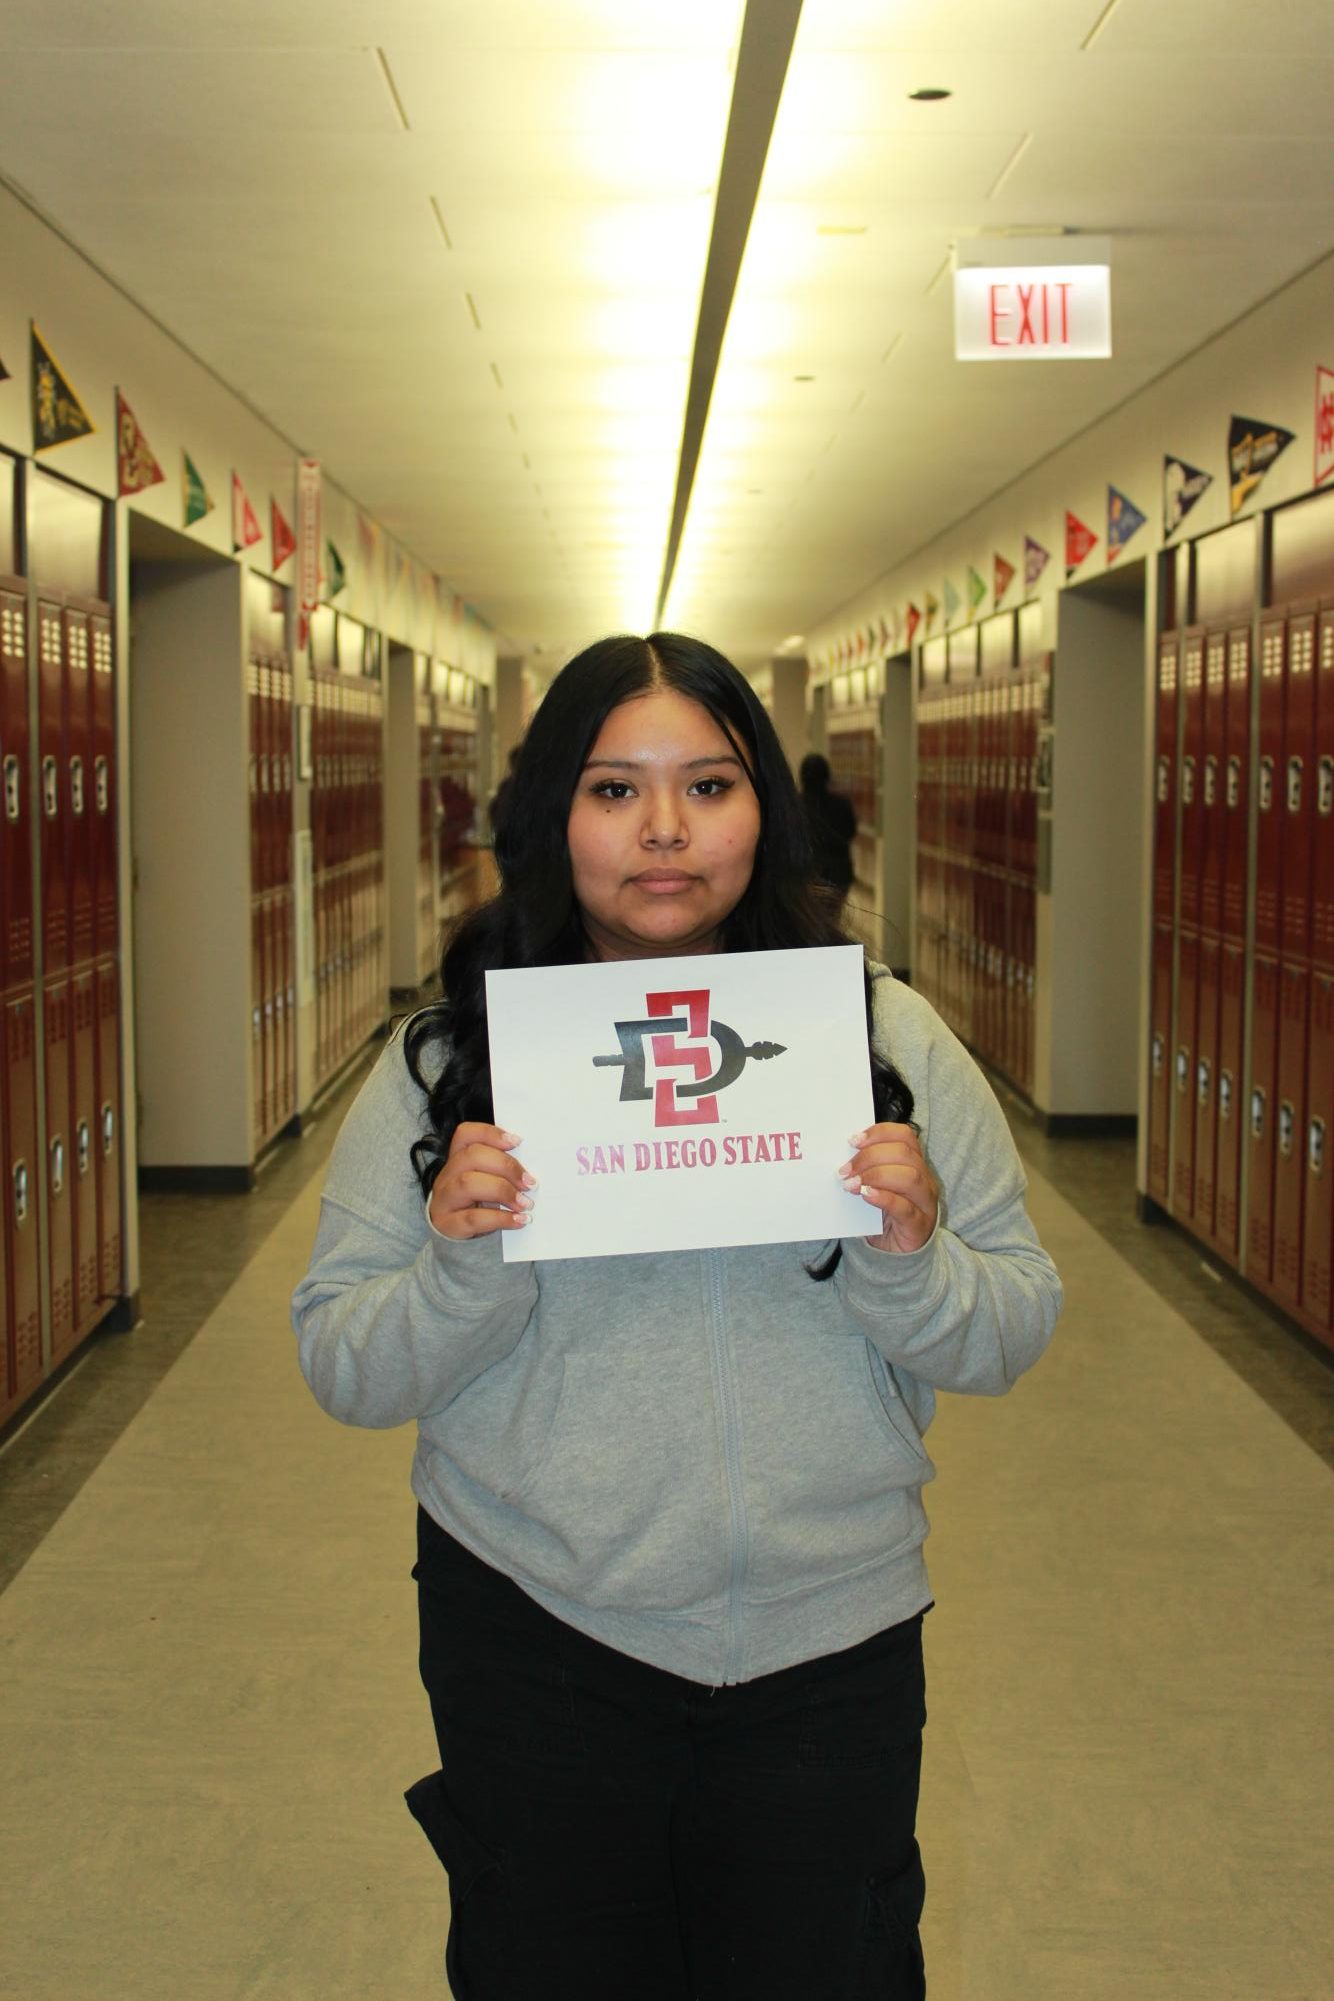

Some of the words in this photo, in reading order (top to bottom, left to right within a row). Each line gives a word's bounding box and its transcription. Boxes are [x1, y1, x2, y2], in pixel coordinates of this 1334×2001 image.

[990, 283, 1072, 346] EXIT
[575, 1143, 626, 1176] SAN
[633, 1137, 717, 1172] DIEGO
[722, 1131, 803, 1166] STATE
